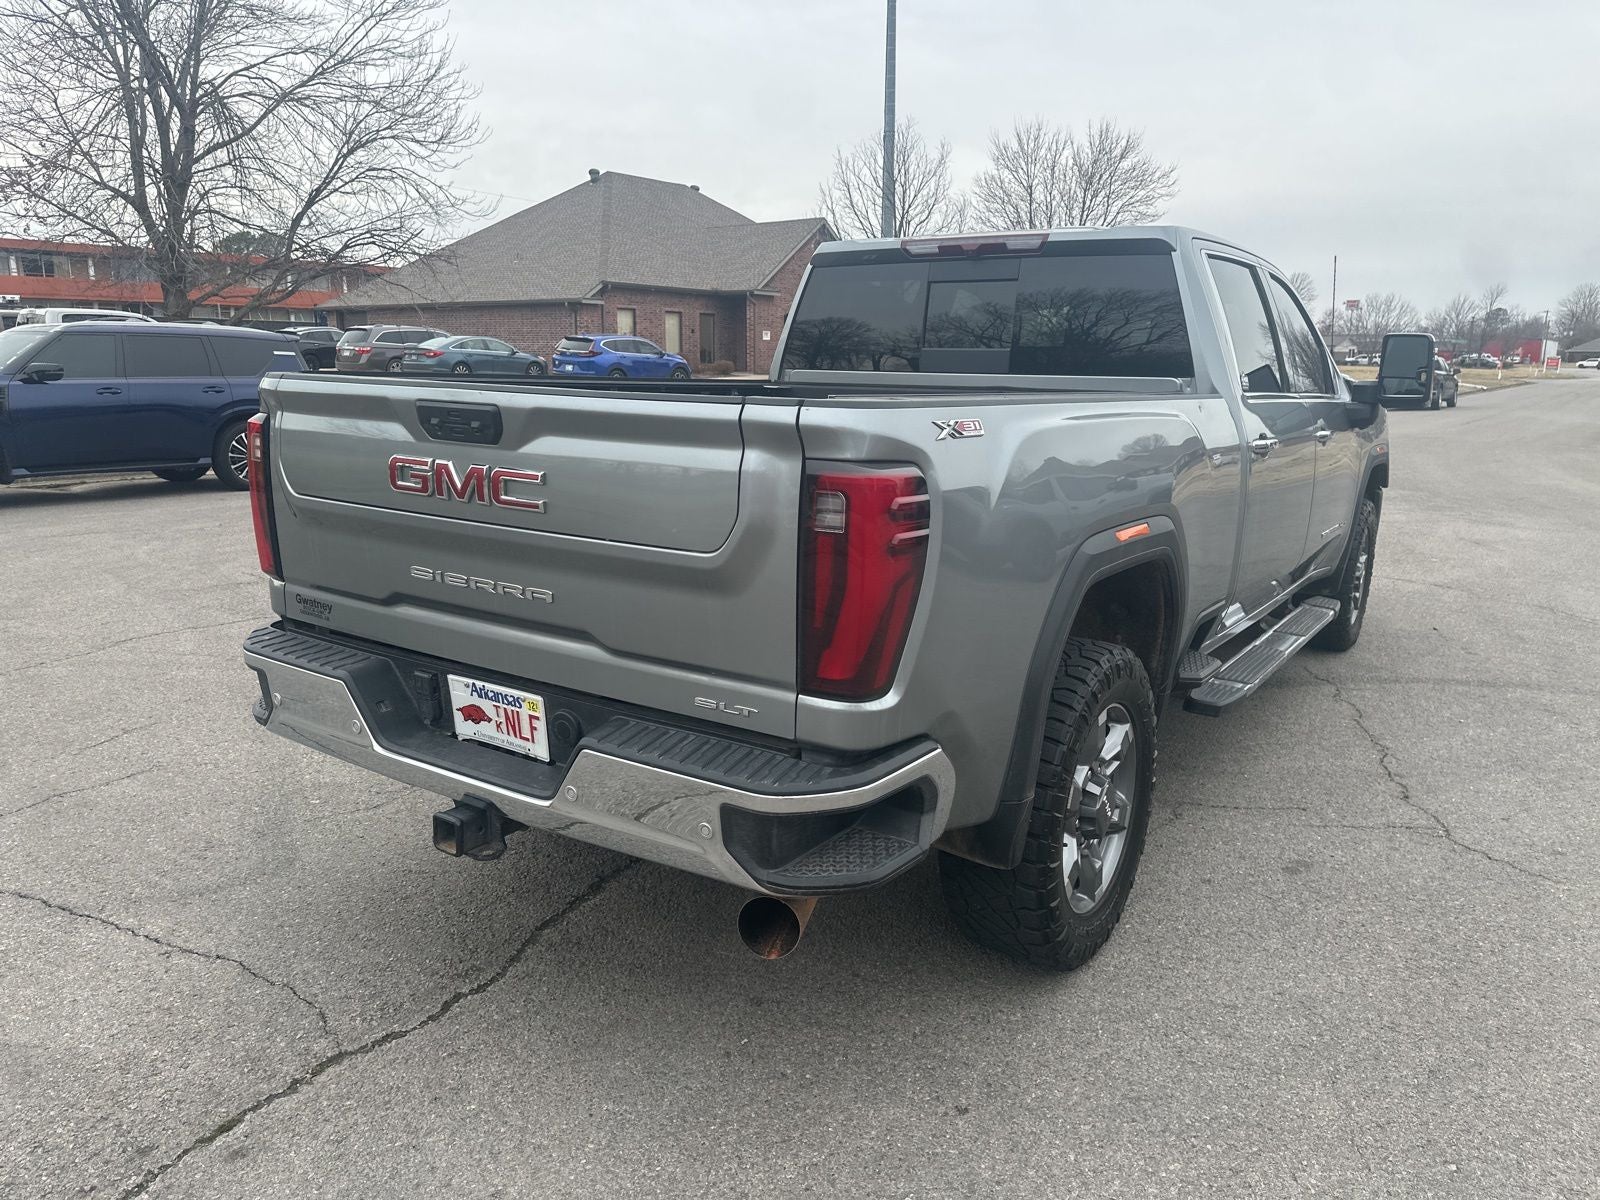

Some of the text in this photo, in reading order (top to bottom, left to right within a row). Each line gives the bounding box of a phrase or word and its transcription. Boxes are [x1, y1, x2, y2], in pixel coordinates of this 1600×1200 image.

[388, 454, 546, 513] GMC
[410, 565, 553, 604] SIERRA
[295, 593, 333, 614] Gwatney
[470, 682, 523, 709] Arkansas
[694, 696, 760, 717] SLT
